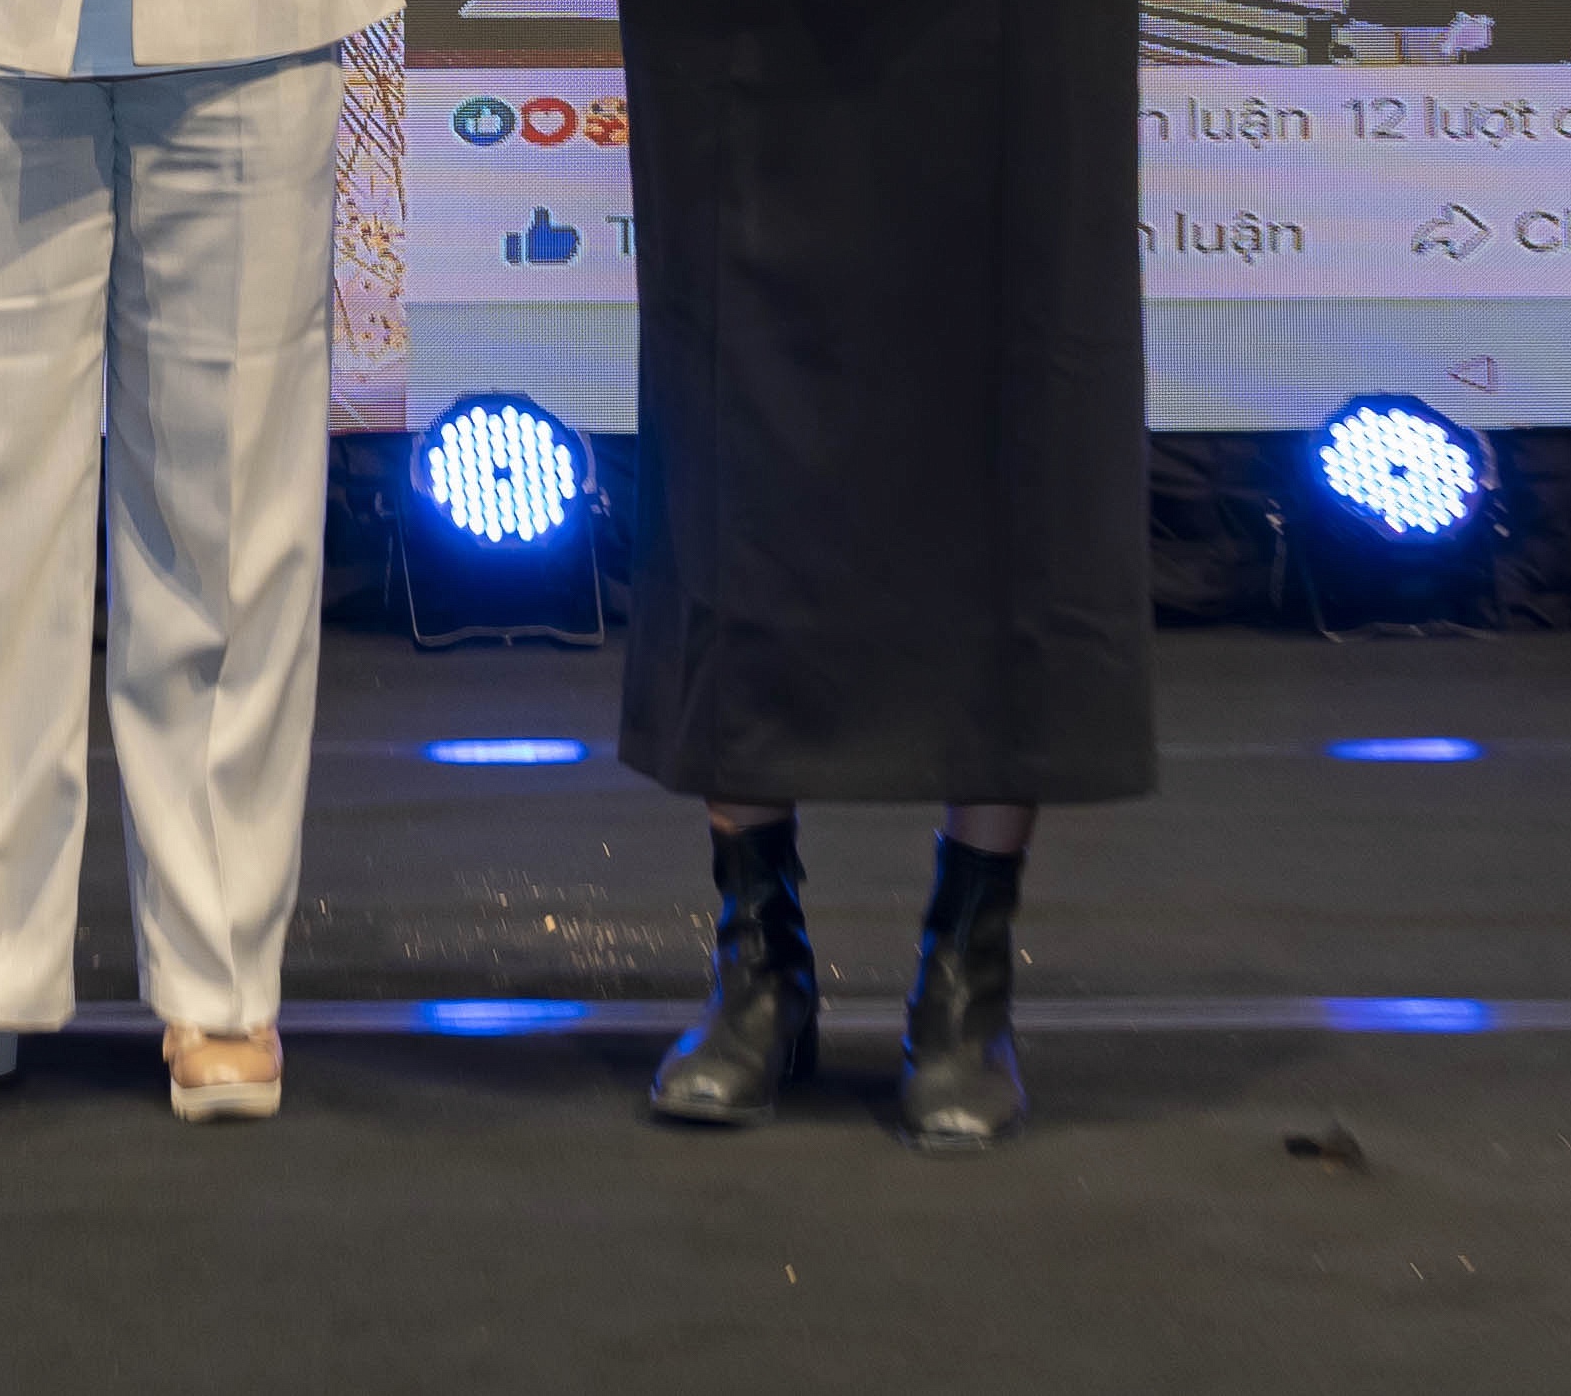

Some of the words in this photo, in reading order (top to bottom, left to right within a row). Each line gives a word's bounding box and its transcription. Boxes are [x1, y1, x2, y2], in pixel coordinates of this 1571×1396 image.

[1189, 96, 1311, 150] luận
[1347, 97, 1407, 140] 12
[1424, 96, 1540, 149] lượt
[1175, 207, 1305, 266] luận
